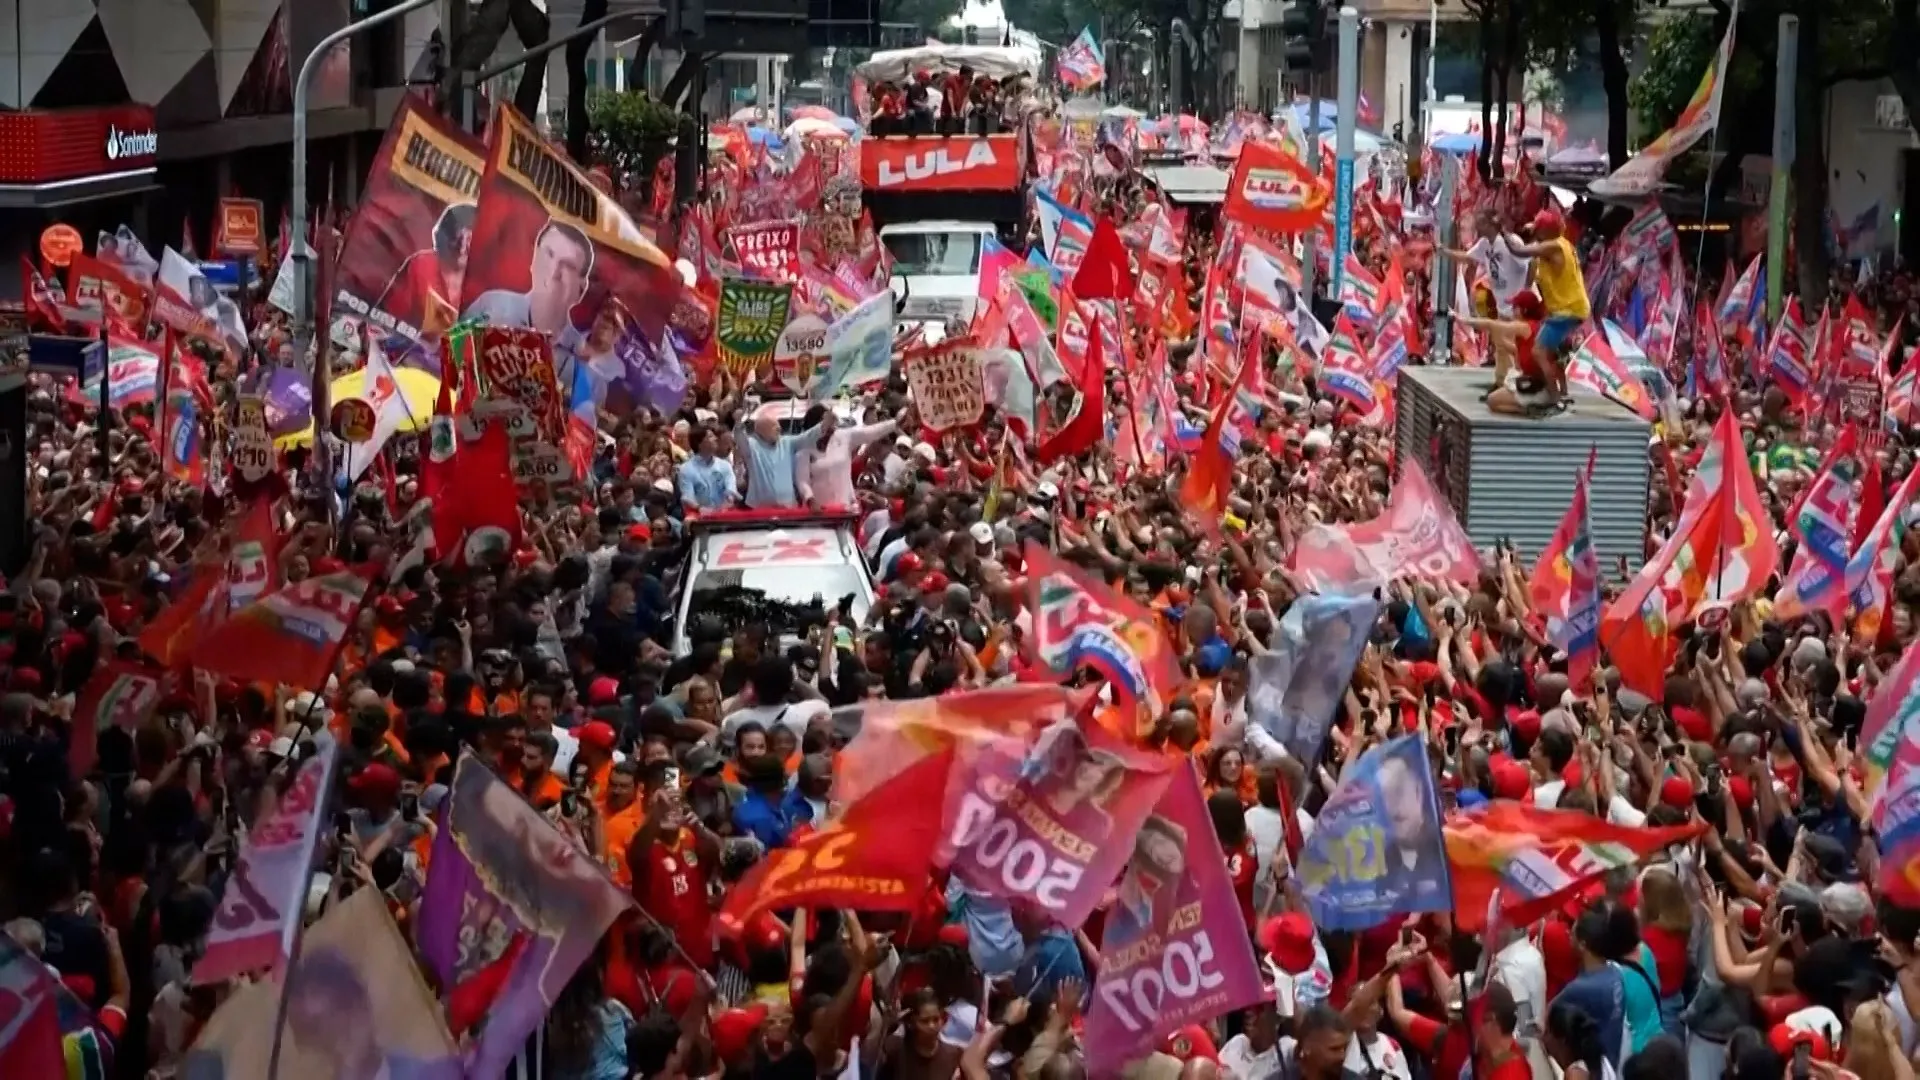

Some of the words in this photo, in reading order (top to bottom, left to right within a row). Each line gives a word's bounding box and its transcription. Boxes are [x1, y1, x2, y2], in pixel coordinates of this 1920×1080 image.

[118, 128, 158, 158] Santander
[878, 141, 997, 187] LULA
[1245, 178, 1301, 196] LULA
[785, 335, 825, 351] 13580
